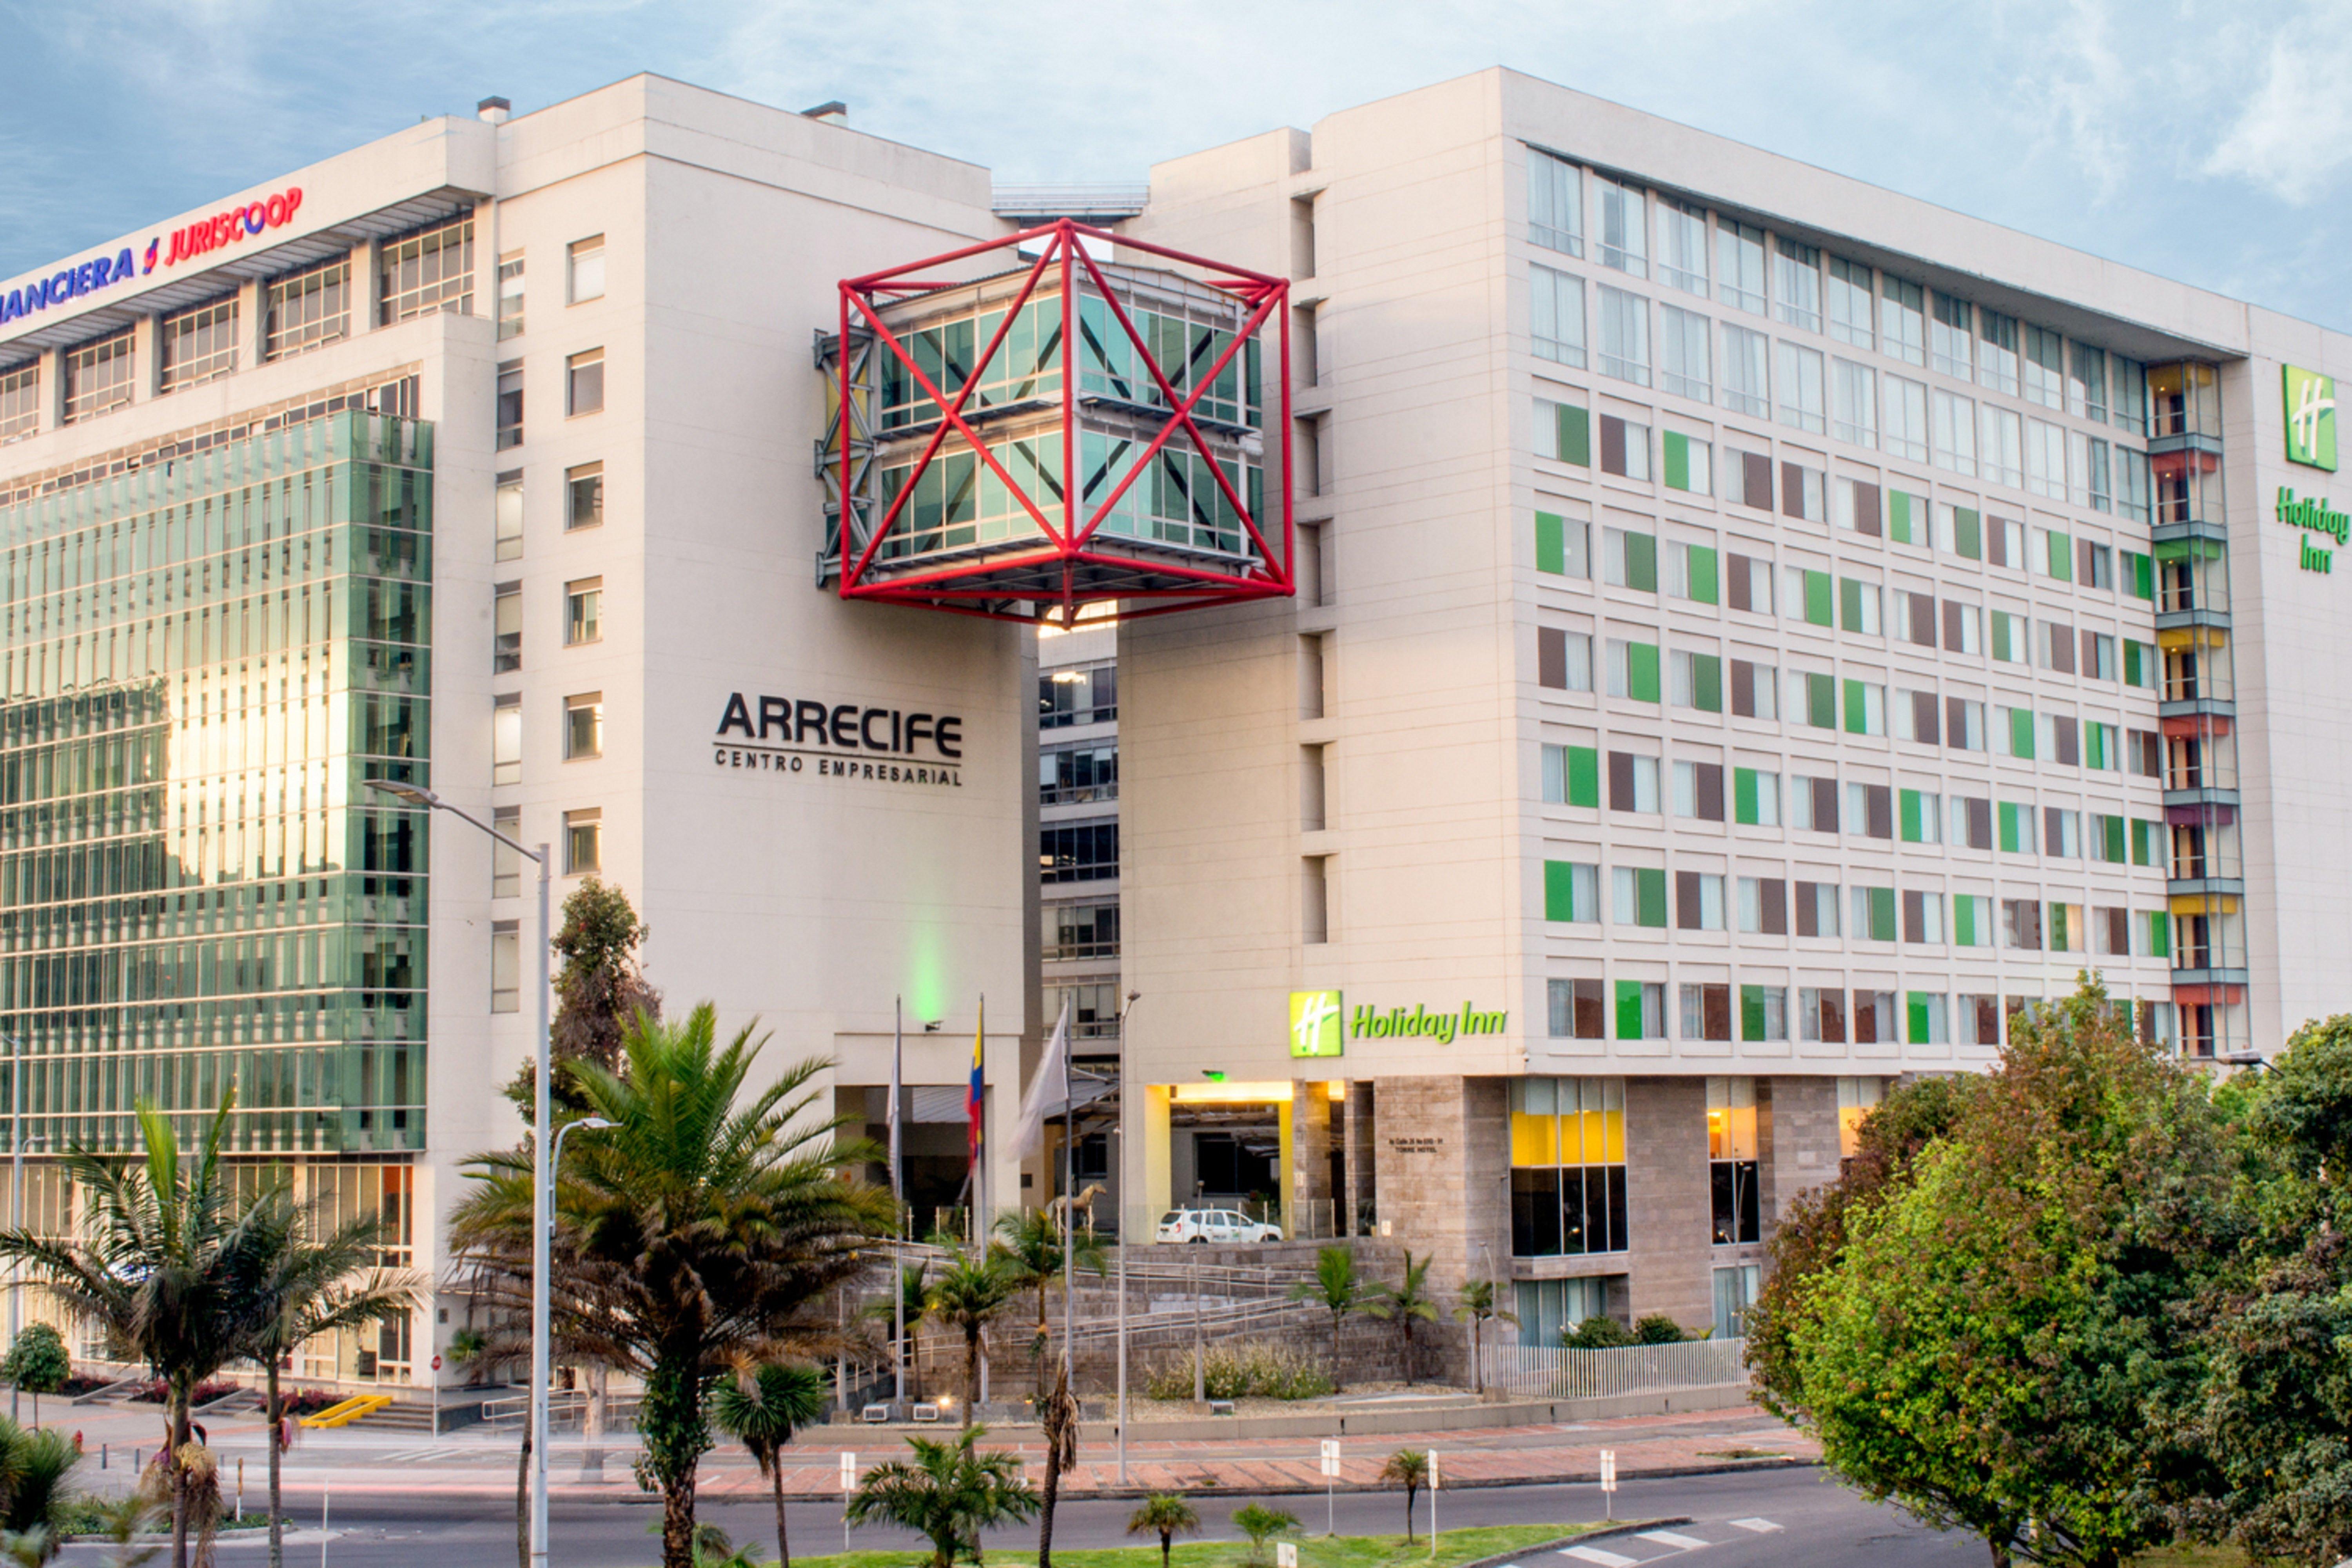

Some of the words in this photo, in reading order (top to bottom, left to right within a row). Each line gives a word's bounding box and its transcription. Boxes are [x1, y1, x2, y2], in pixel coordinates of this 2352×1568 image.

[0, 247, 134, 325] ANCIERA
[164, 187, 302, 267] JURISCOOP
[2275, 486, 2350, 546] Holiday
[2300, 533, 2333, 574] Inn
[715, 692, 962, 758] ARRECIFE
[715, 749, 803, 772] CENTRO
[818, 759, 962, 786] EMPRESARIAL
[1350, 1003, 1457, 1044] Holiday
[1460, 1000, 1506, 1034] Inn
